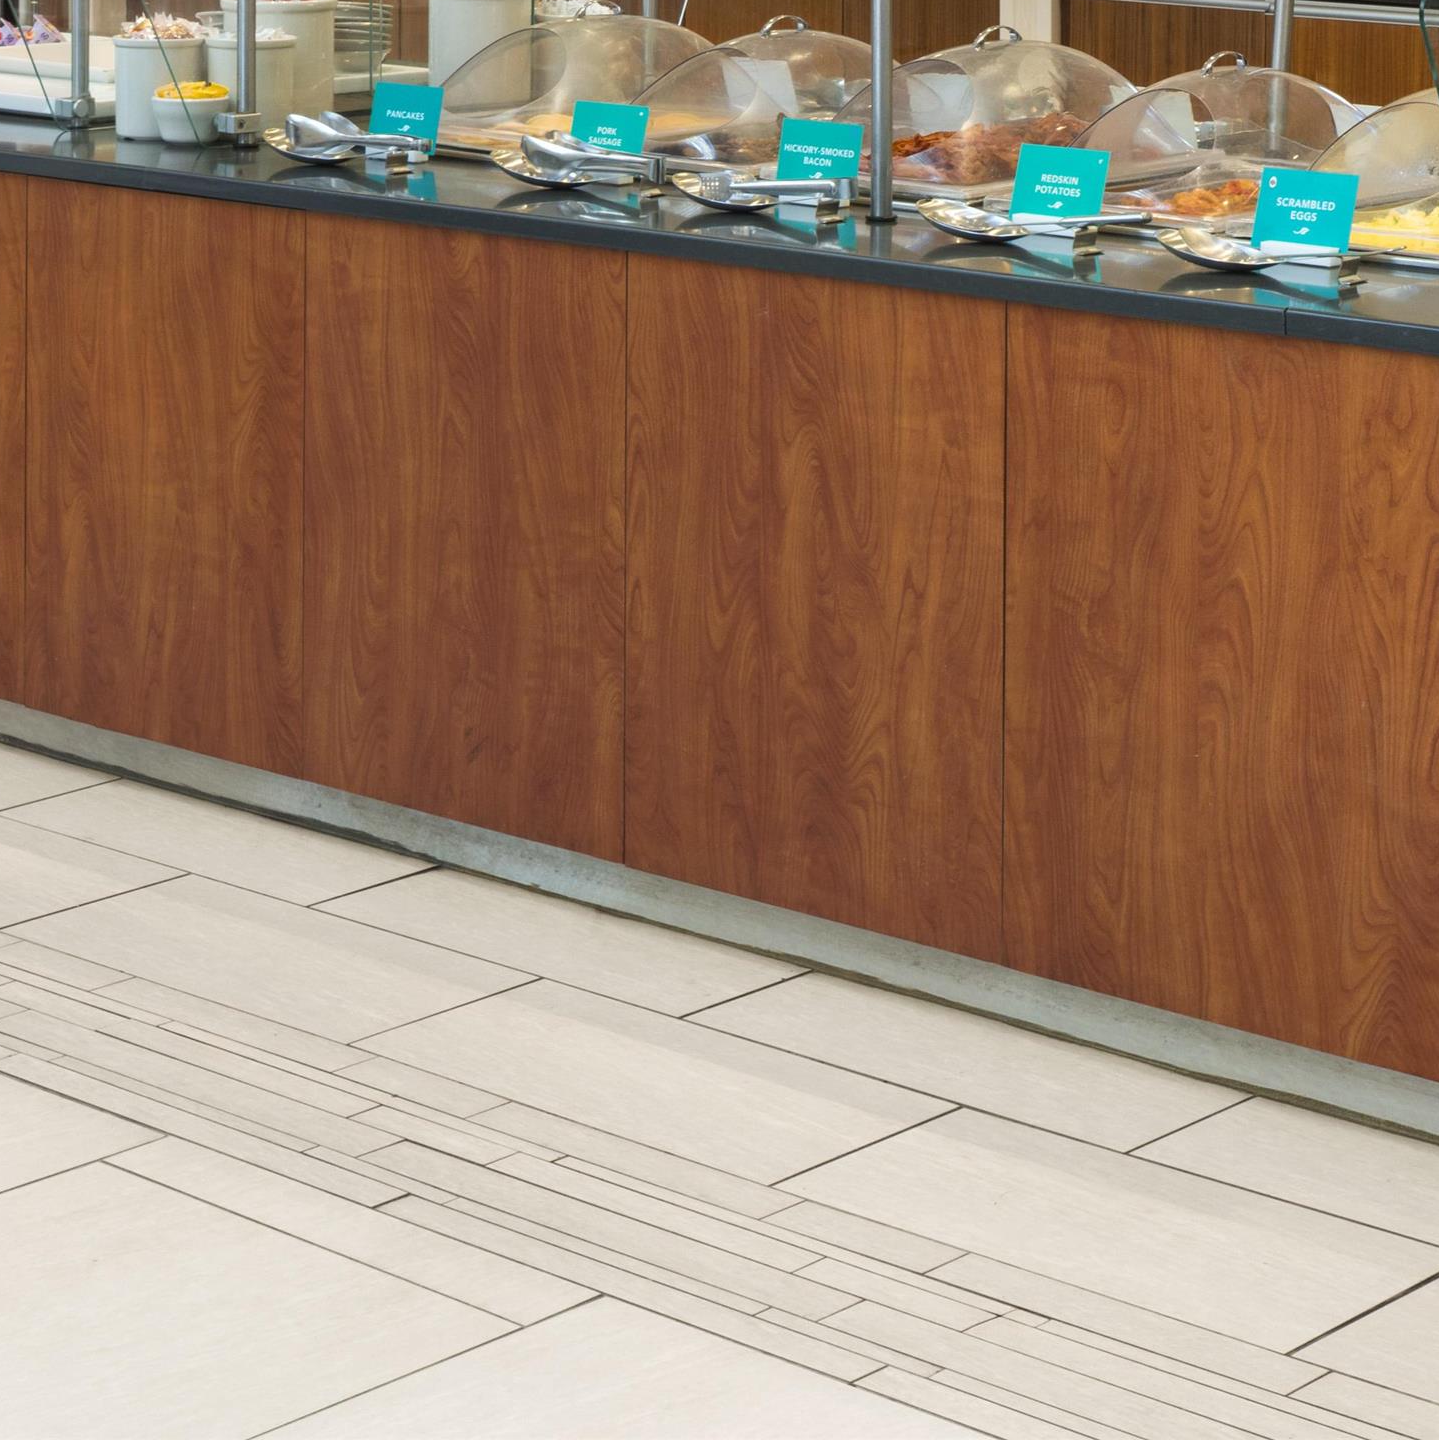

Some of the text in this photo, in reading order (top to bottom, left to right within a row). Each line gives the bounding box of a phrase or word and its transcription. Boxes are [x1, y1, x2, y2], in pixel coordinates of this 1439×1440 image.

[386, 109, 425, 121] PANCAKES
[596, 126, 617, 136] PORK
[588, 135, 622, 147] SAUSAGE
[783, 143, 855, 158] HICKORY-SMOKED
[803, 156, 832, 167] BACON
[1040, 173, 1080, 186] REDSKIN
[1034, 184, 1081, 198] POTATOES
[1275, 196, 1336, 211] SCRAMBLED
[1290, 210, 1318, 222] EGGS
